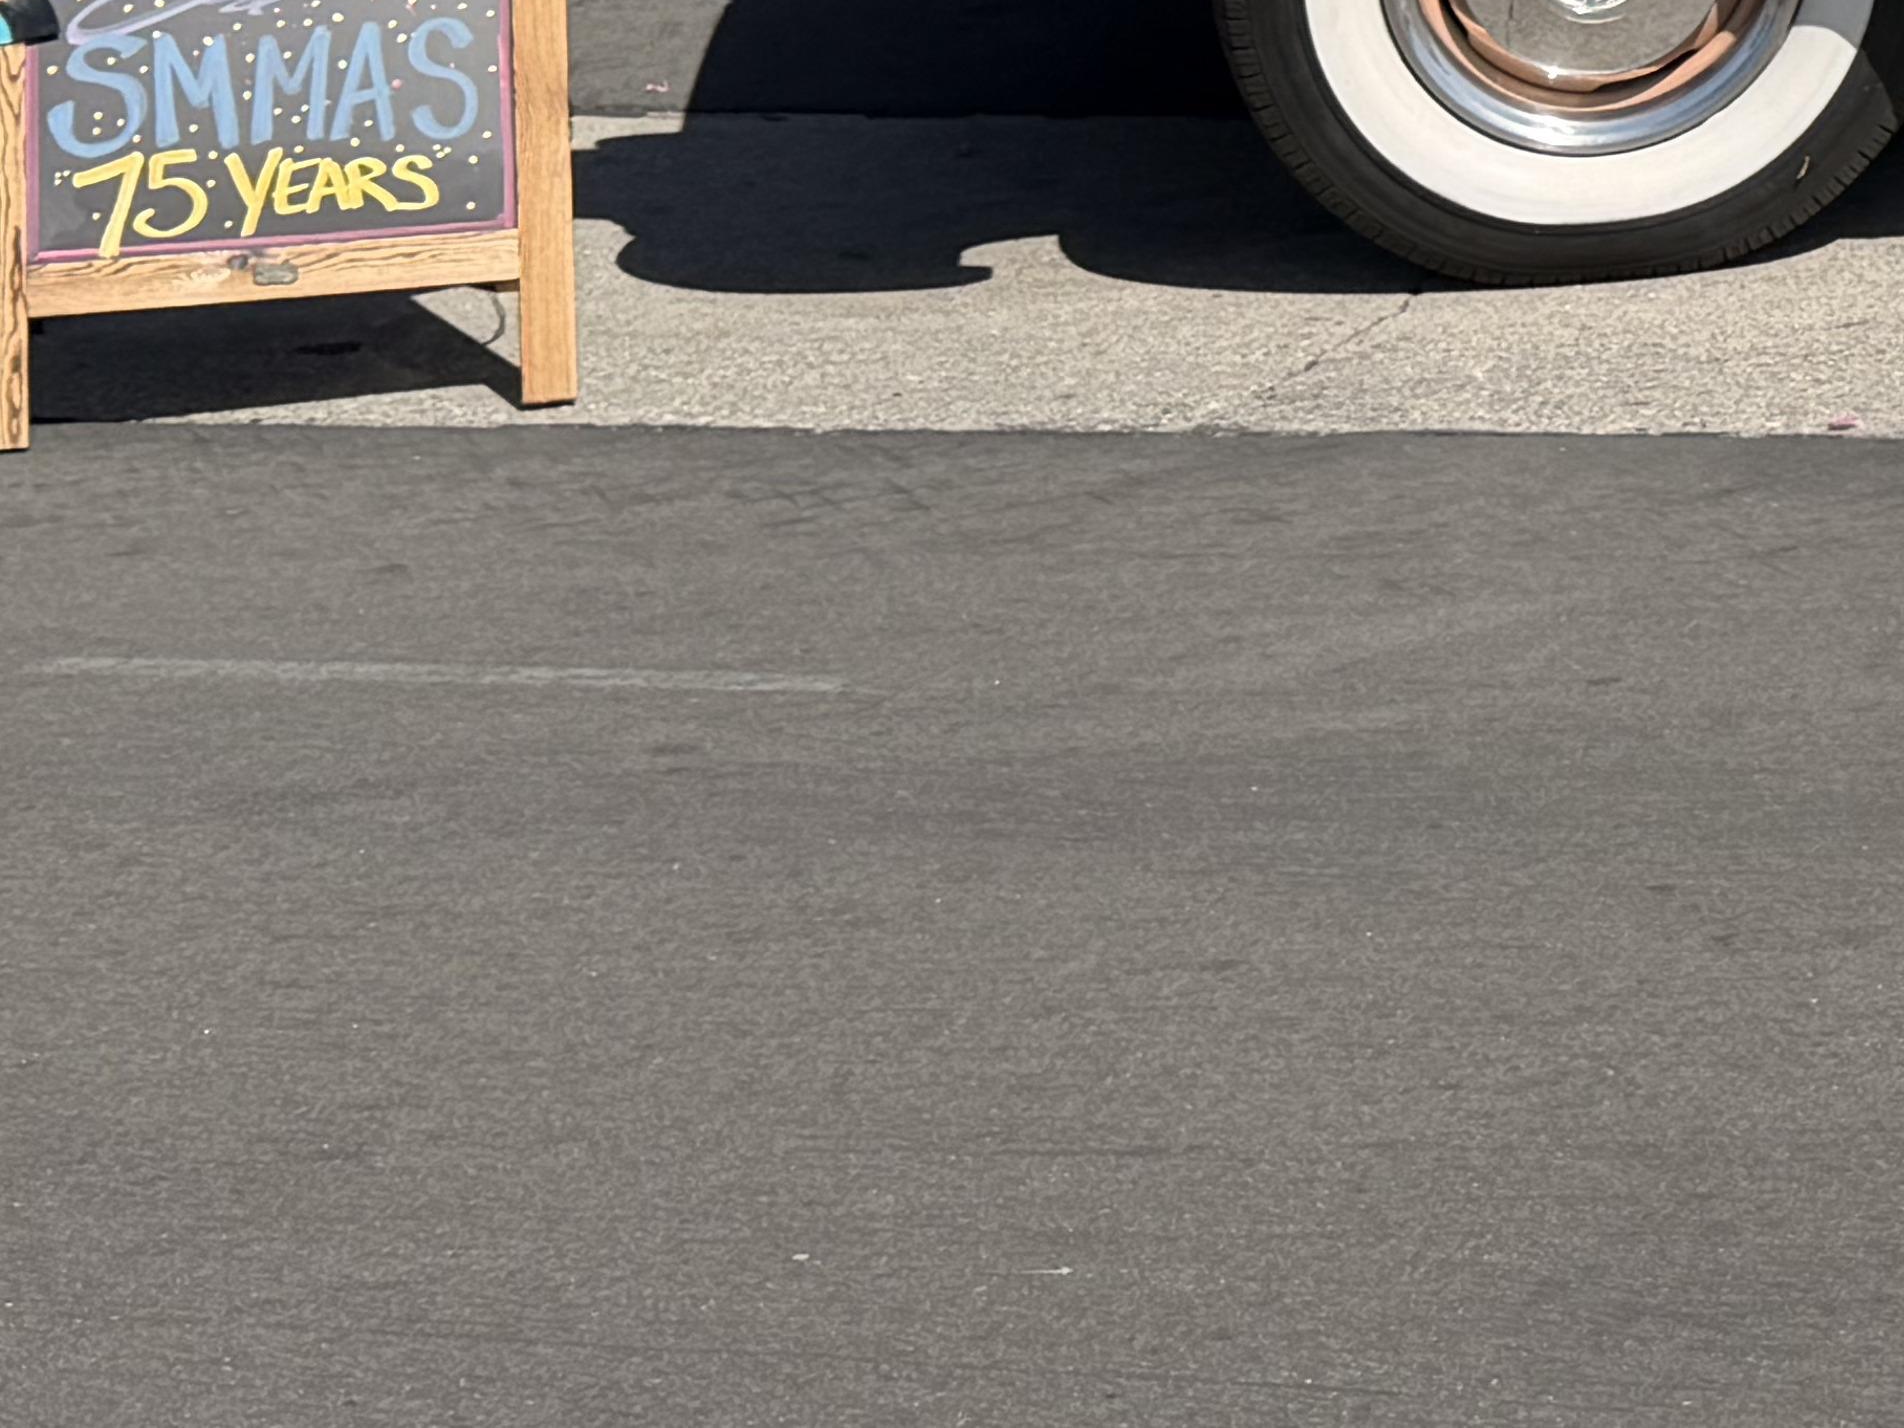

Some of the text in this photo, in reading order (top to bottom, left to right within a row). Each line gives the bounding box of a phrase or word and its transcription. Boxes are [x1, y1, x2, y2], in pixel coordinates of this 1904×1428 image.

[46, 16, 480, 160] SMMAS
[72, 145, 441, 258] 75 YEARS
